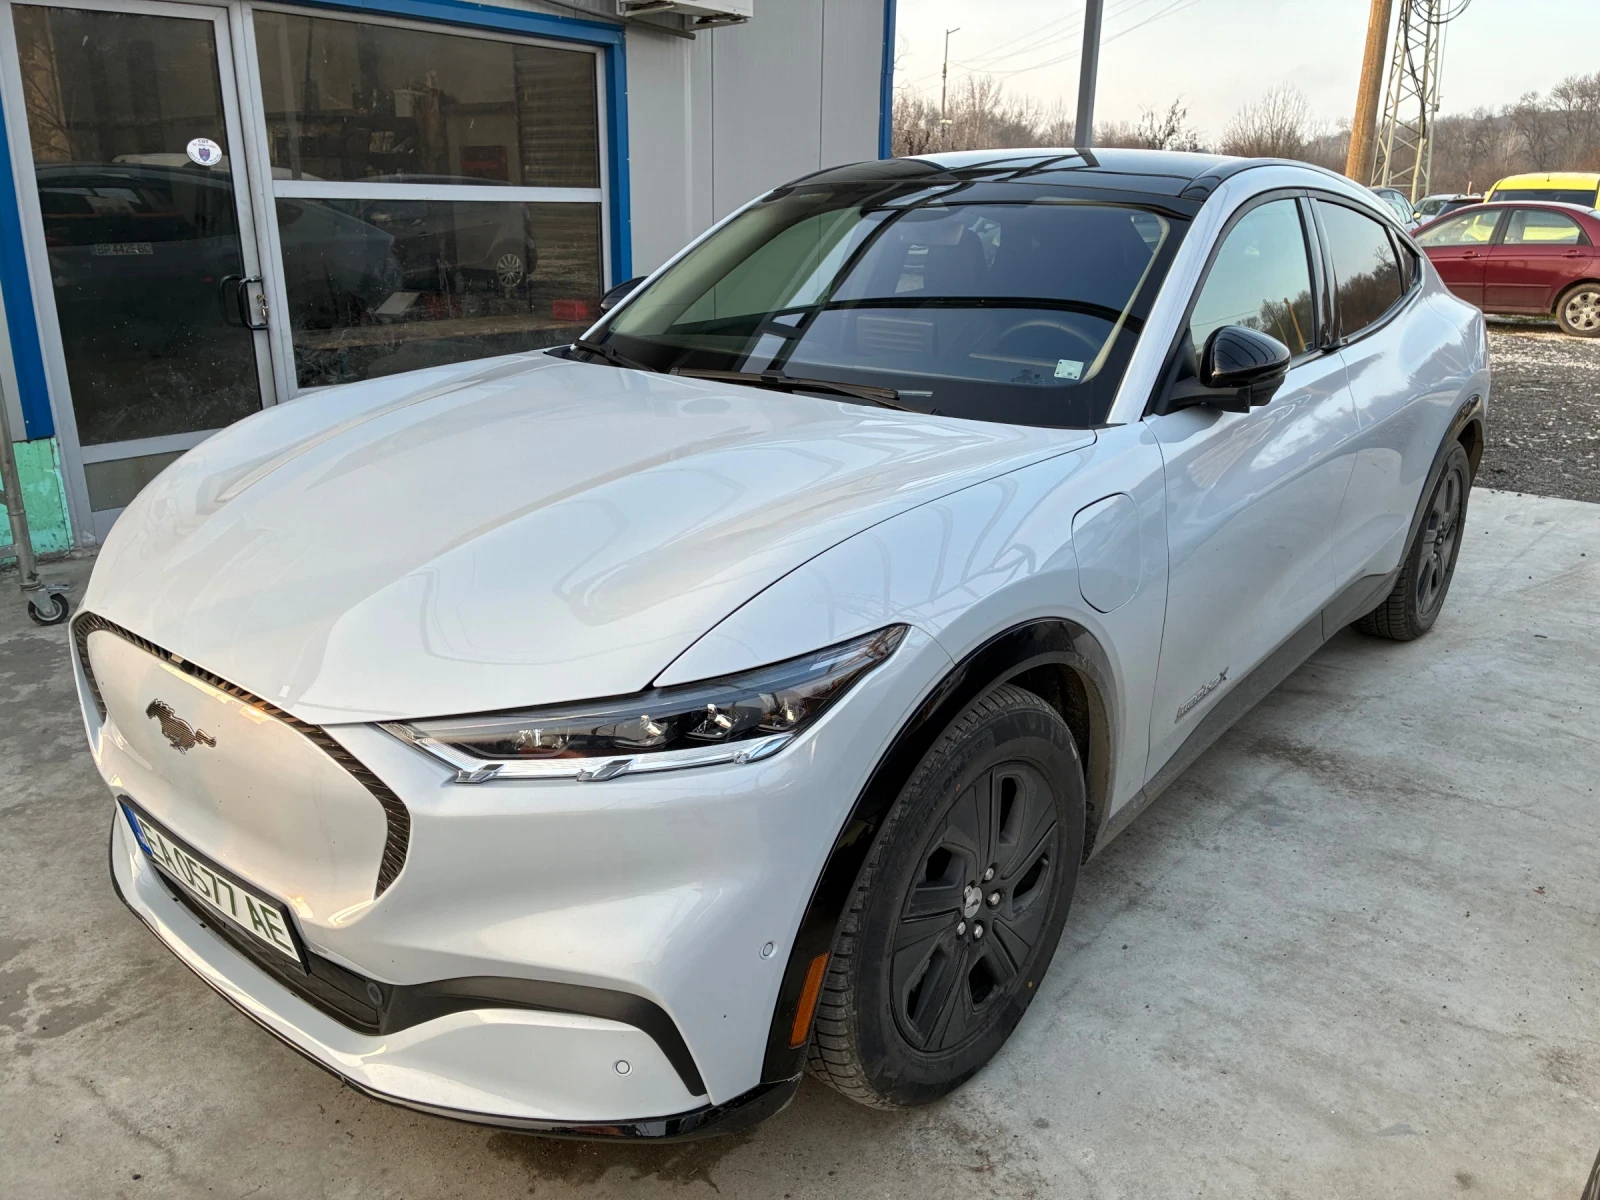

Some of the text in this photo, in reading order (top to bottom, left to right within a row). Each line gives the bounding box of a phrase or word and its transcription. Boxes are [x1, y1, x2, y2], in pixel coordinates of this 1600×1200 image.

[138, 818, 294, 953] EA 0577 AE
